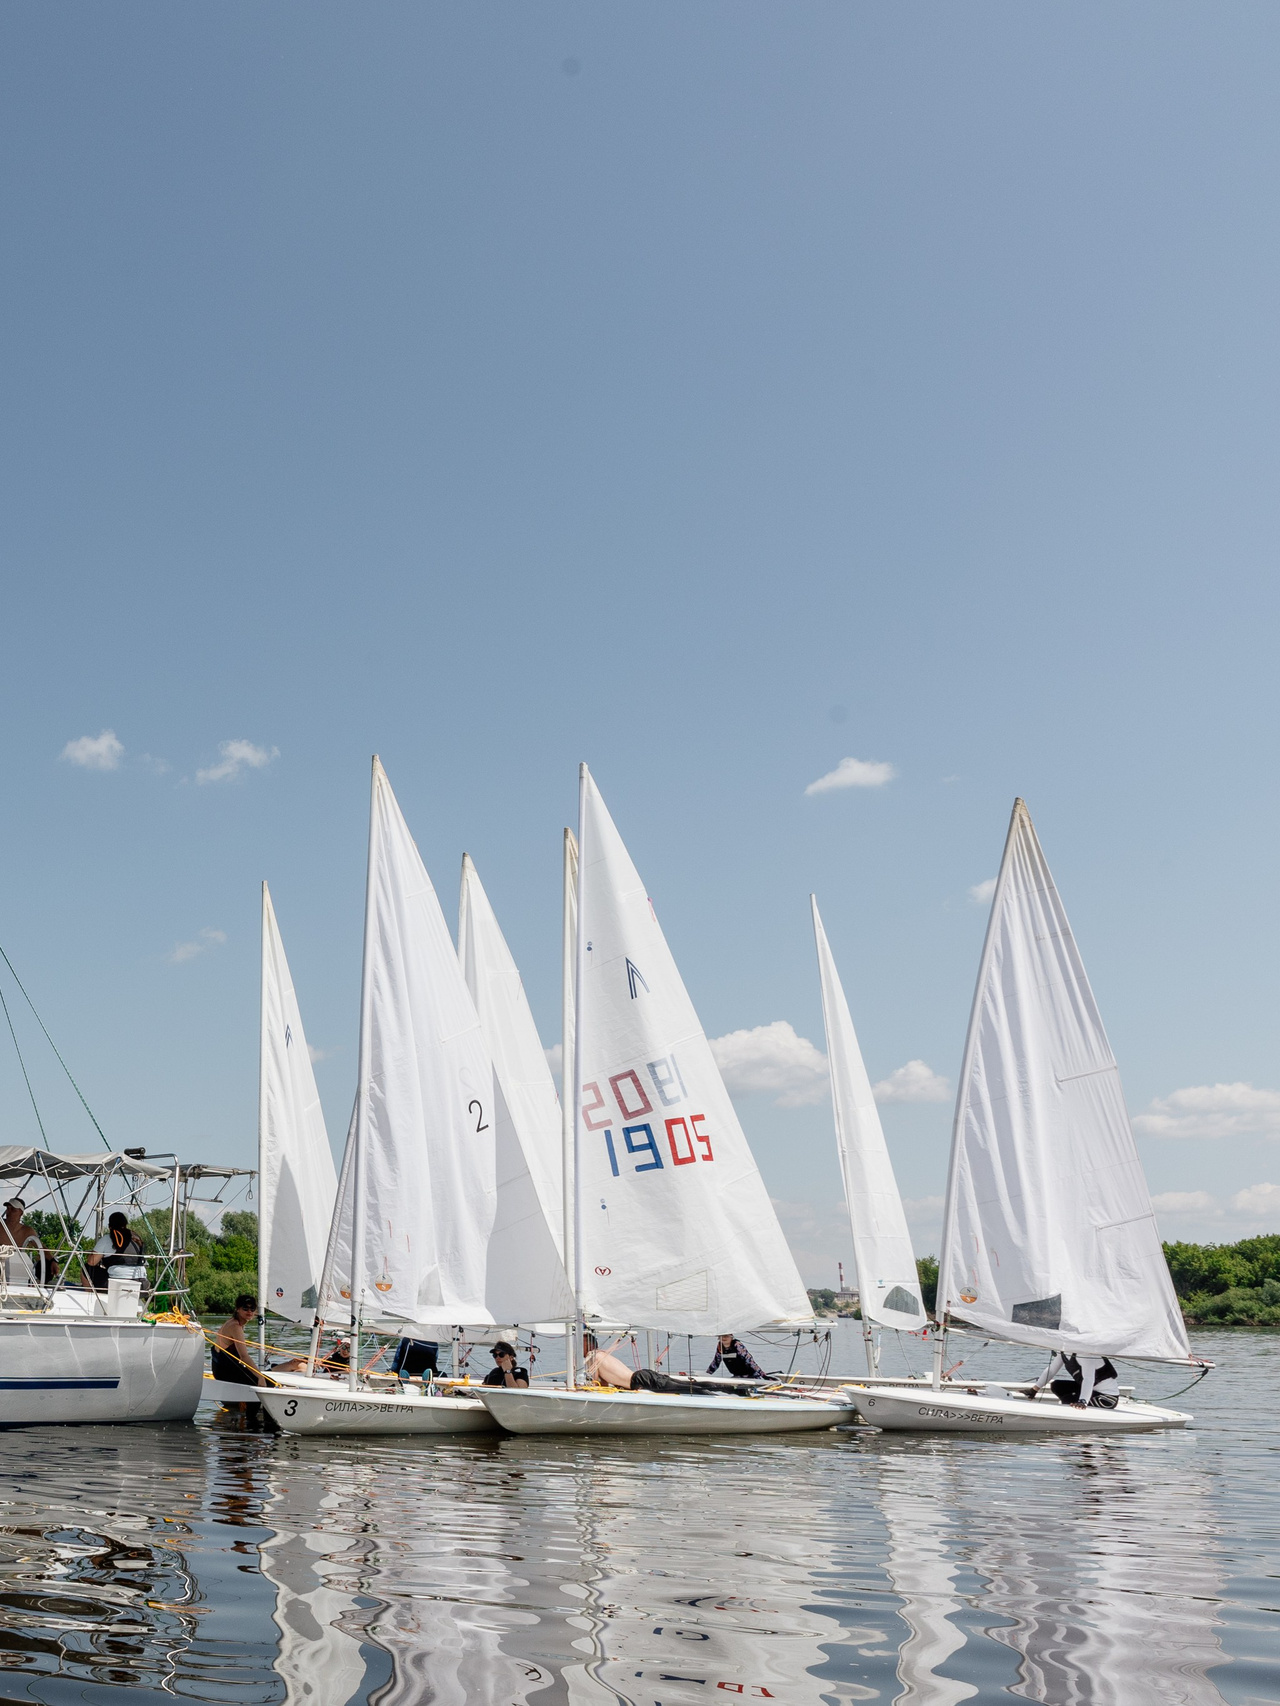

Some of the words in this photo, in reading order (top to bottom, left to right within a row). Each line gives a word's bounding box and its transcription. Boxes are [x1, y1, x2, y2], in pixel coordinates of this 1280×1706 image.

[468, 1099, 489, 1133] 2
[604, 1113, 714, 1177] 1905
[283, 1399, 299, 1417] 3
[867, 1398, 876, 1407] 6
